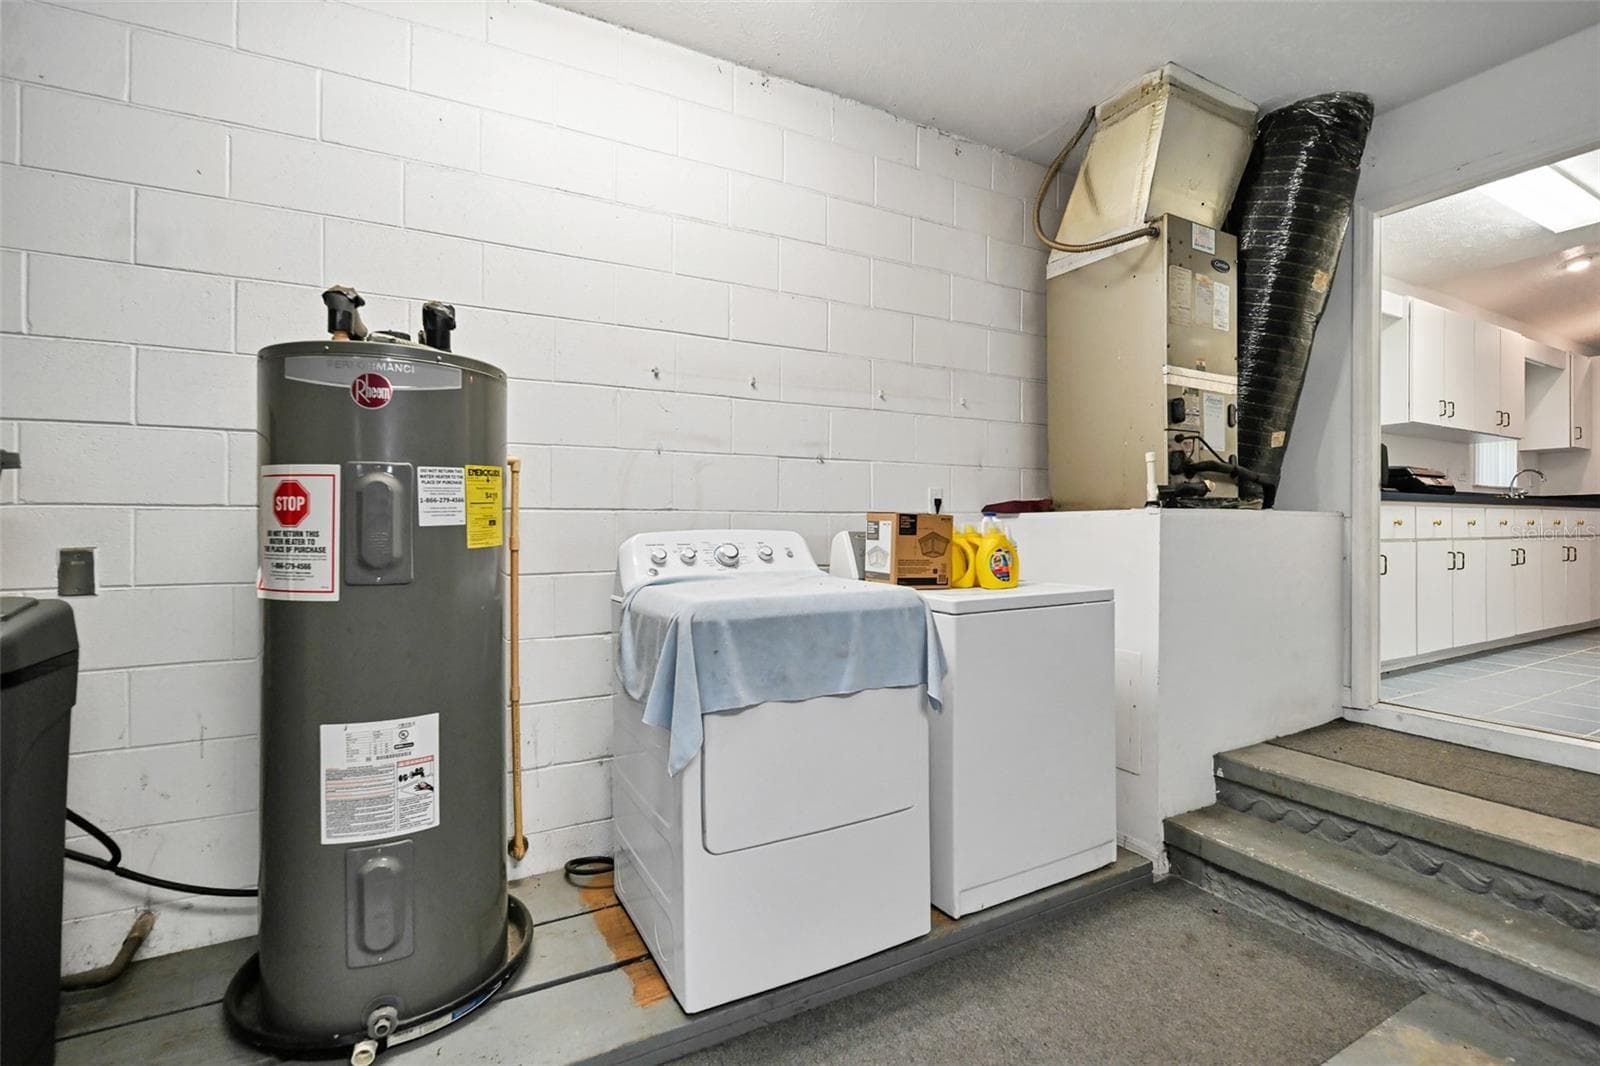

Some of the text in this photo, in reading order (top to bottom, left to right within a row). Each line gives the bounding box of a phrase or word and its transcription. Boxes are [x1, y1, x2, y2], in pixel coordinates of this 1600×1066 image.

[355, 374, 390, 403] Rheem
[275, 496, 305, 511] STOP
[283, 530, 304, 538] RETURN
[285, 538, 306, 546] HEATER
